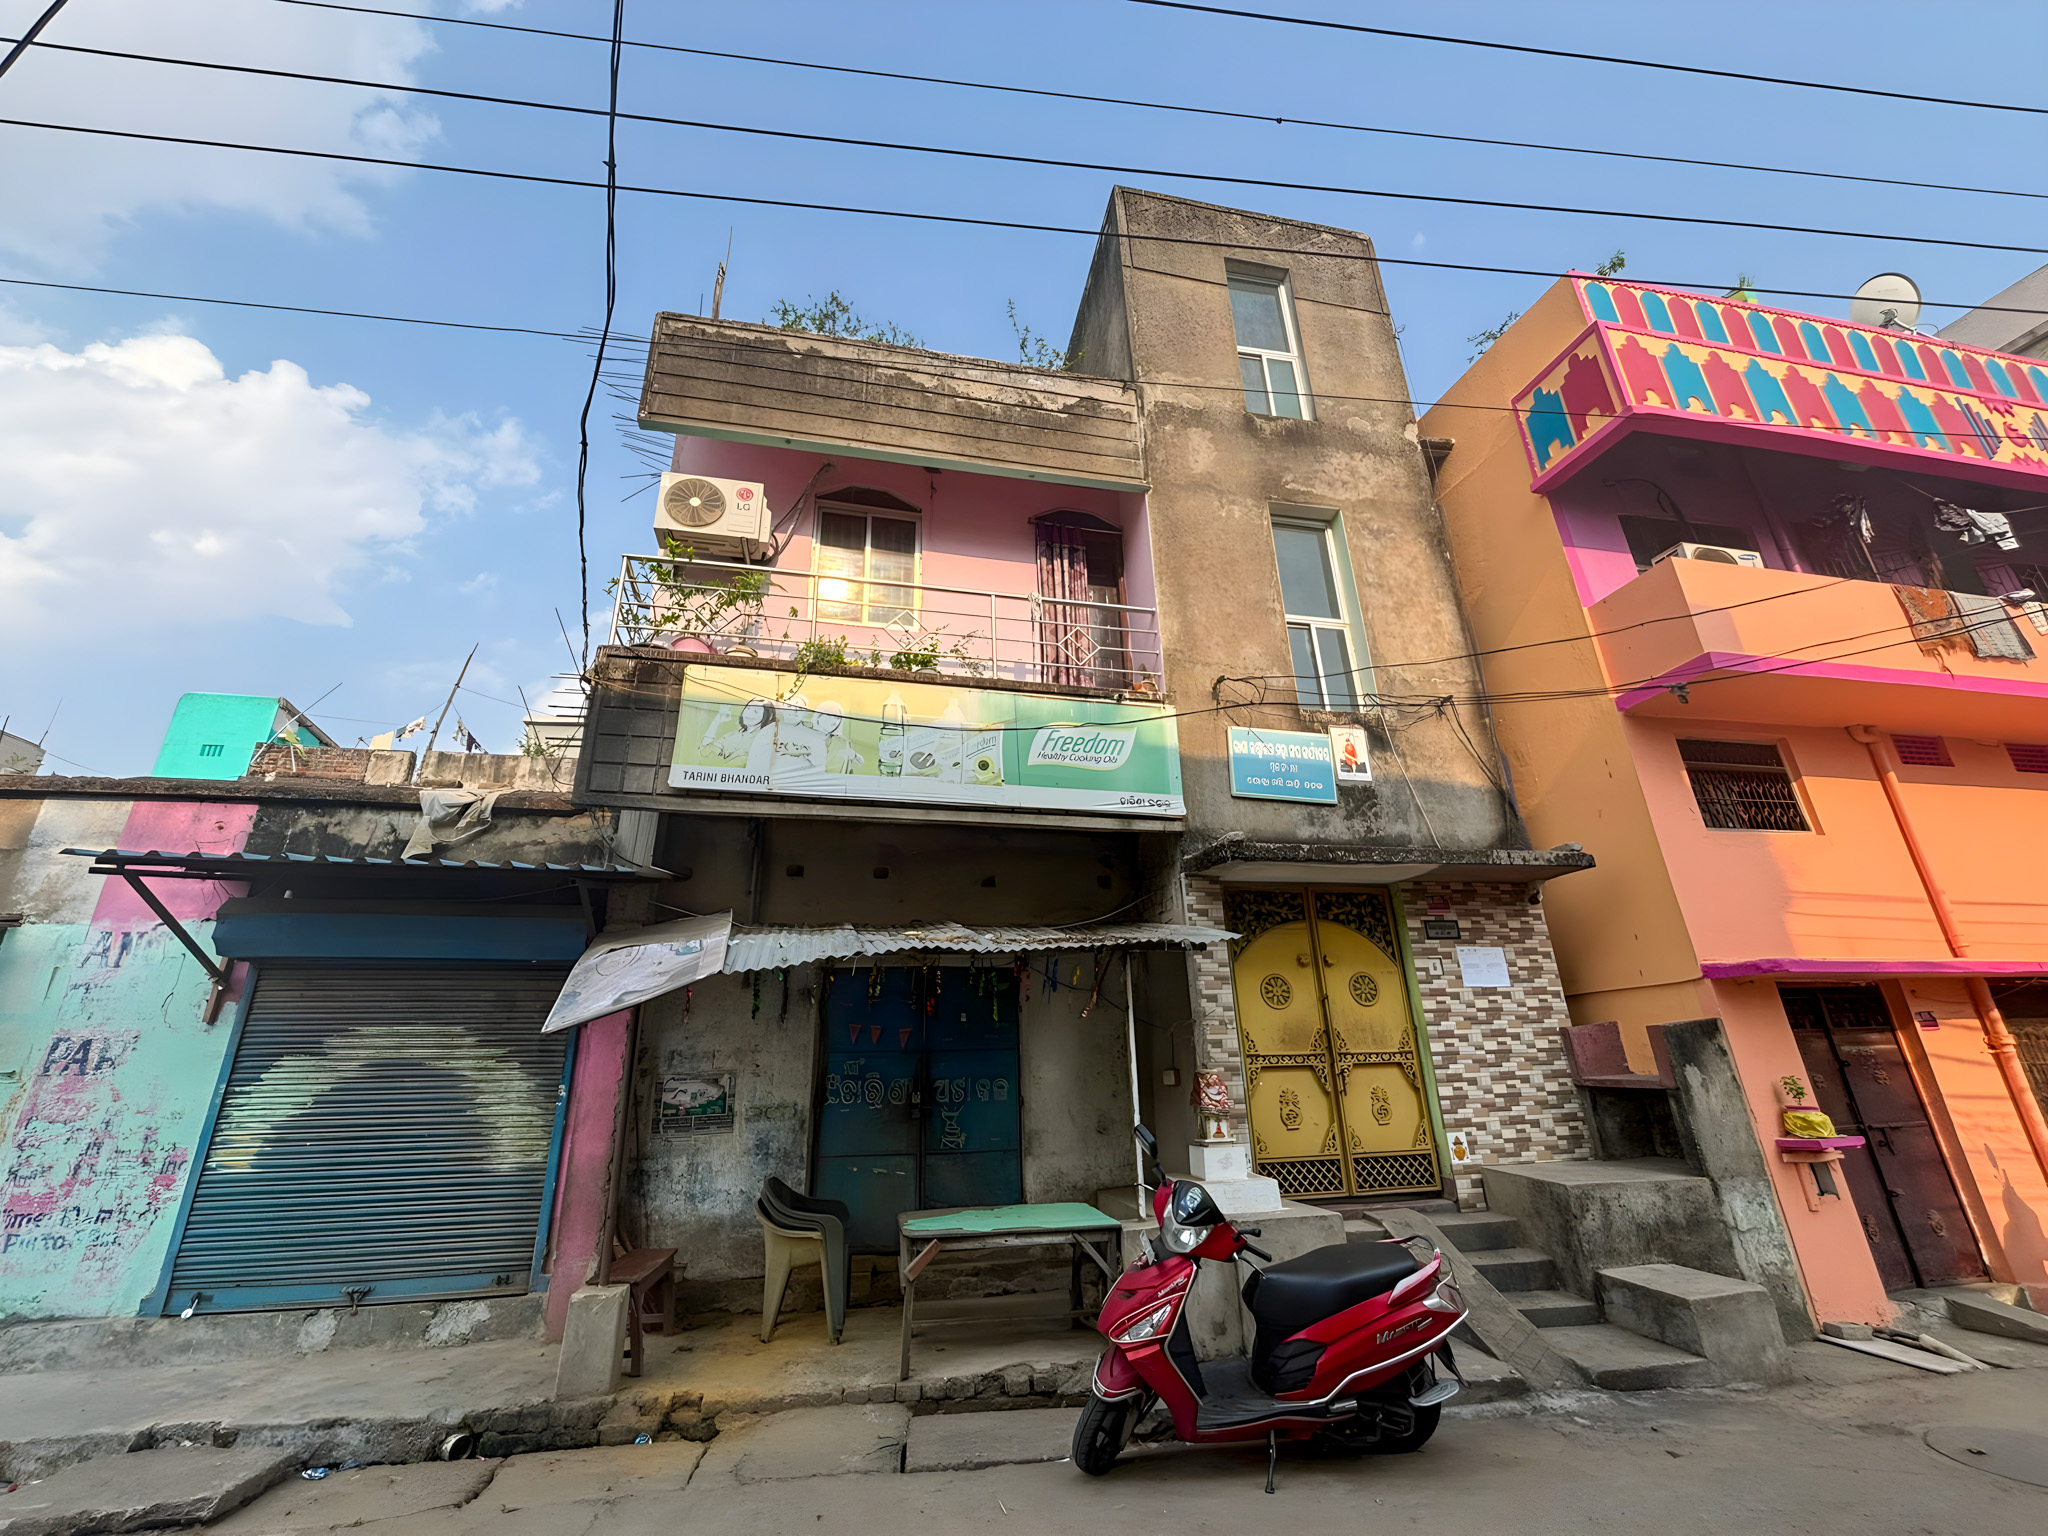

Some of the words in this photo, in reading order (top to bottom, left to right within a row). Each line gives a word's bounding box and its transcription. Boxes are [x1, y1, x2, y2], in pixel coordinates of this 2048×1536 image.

[1041, 729, 1125, 756] Freedom
[1037, 751, 1068, 761] Healthy
[1069, 753, 1102, 764] Cooking
[683, 770, 718, 783] TARINI
[720, 773, 770, 785] BHANDAR
